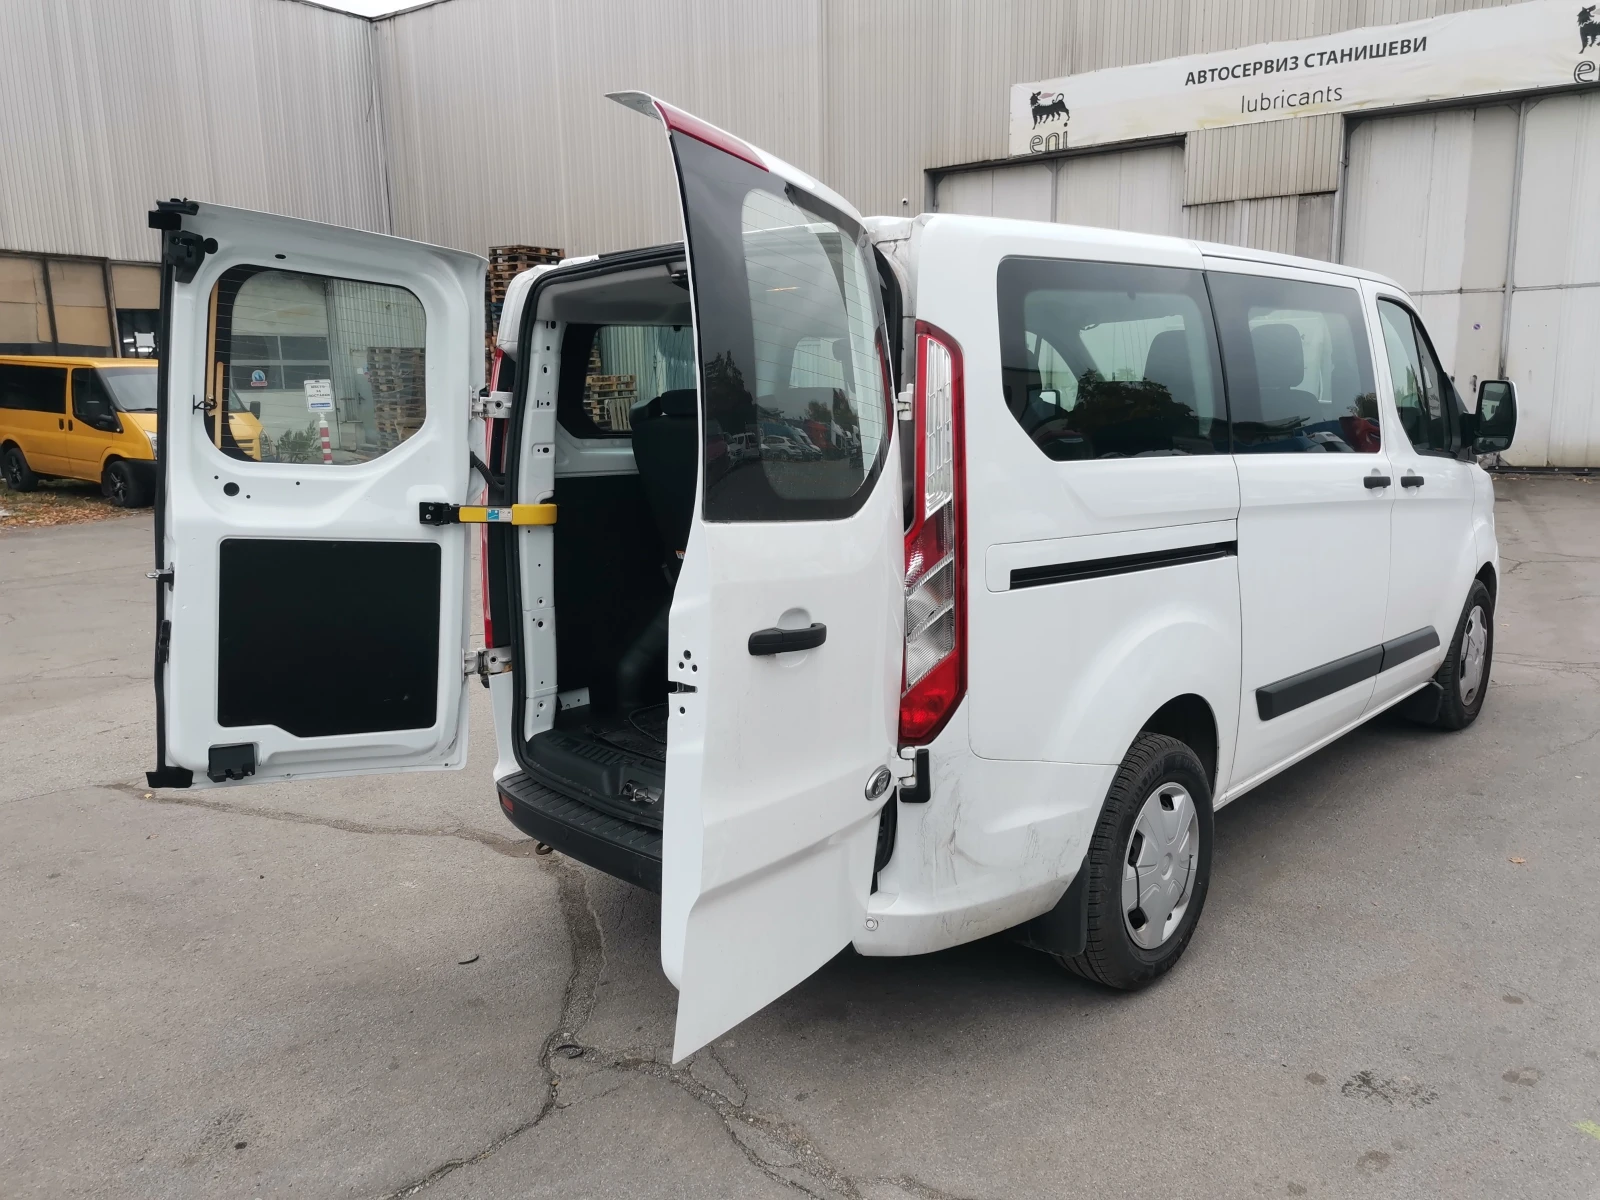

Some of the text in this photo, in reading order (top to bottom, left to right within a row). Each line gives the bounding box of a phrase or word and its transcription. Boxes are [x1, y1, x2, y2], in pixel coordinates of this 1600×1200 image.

[1184, 36, 1427, 86] АВТОСЕРВИЗ СТАНИШЕВИ
[1241, 85, 1343, 114] lubricants
[1029, 122, 1068, 154] eni
